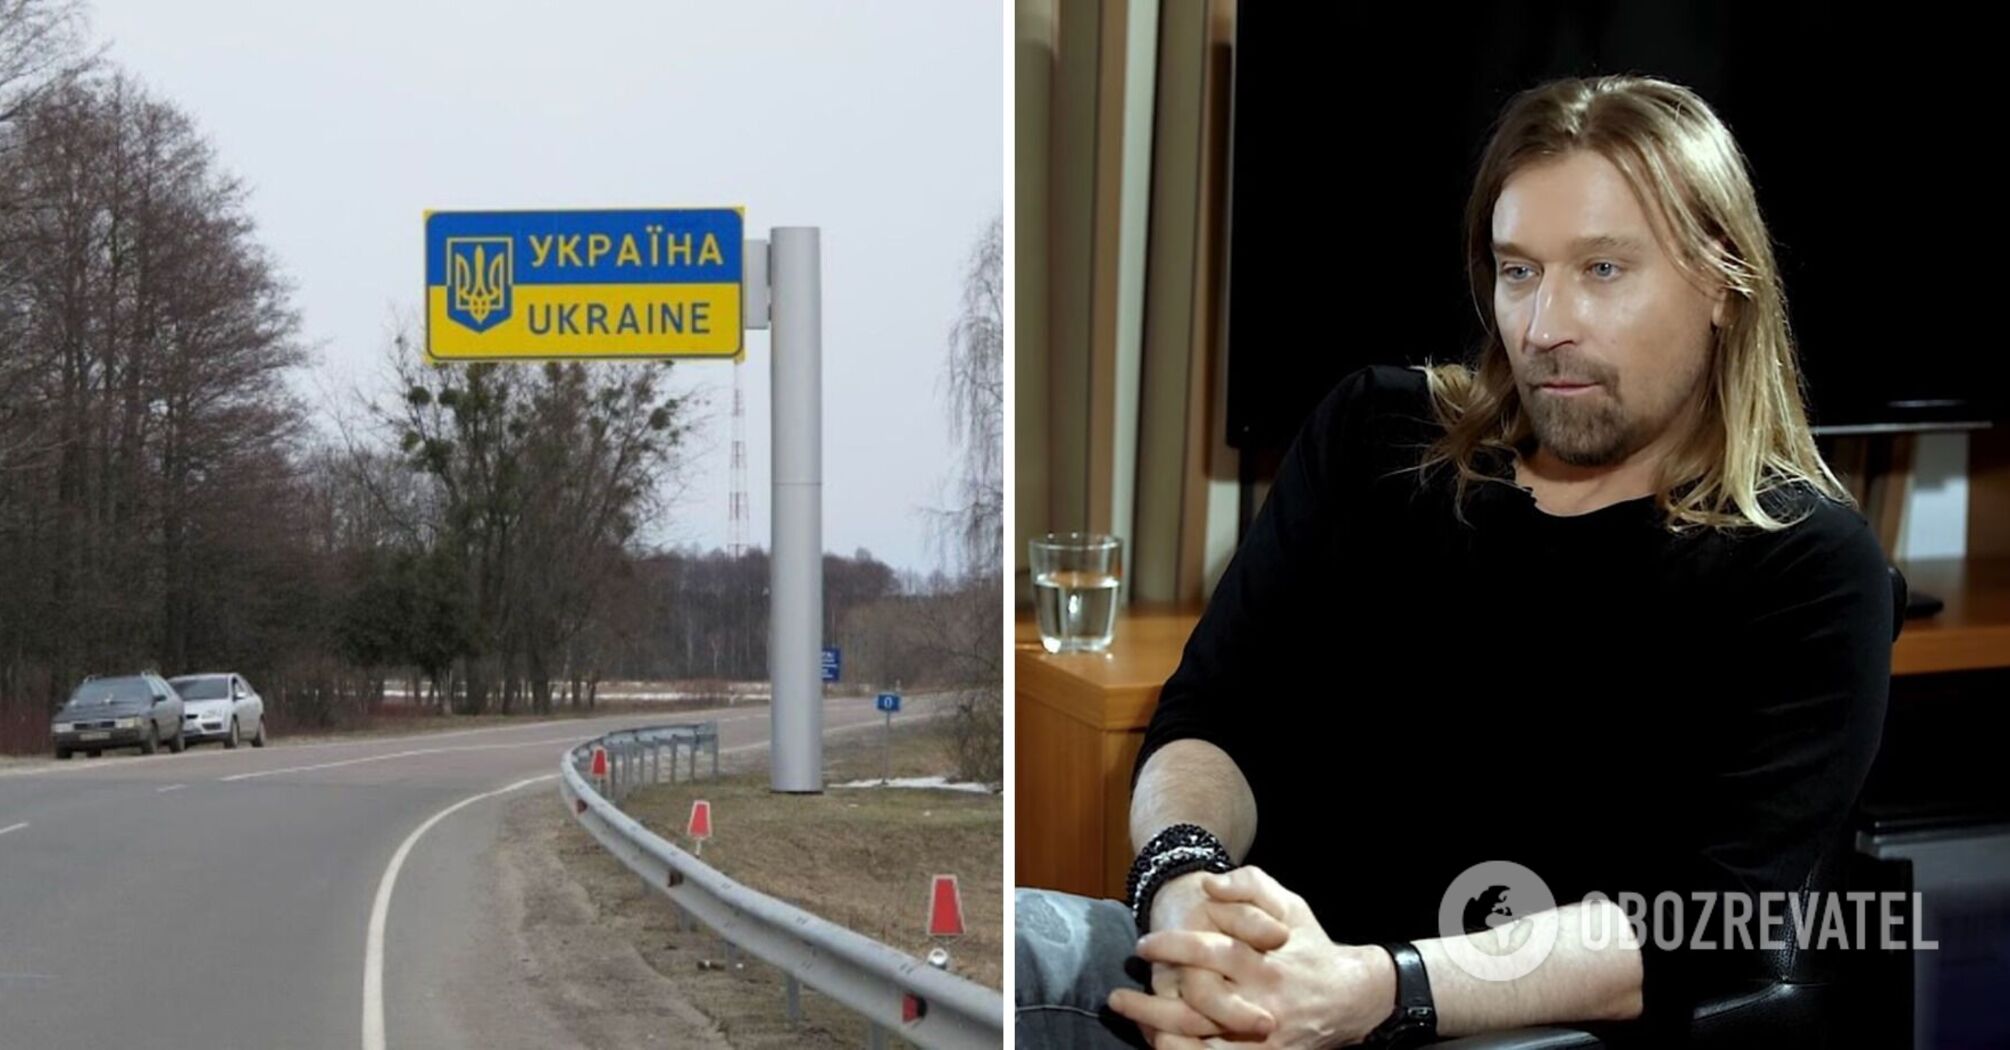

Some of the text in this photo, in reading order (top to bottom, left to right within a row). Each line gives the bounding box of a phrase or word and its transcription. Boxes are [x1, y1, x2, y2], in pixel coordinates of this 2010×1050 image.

[529, 225, 723, 267] УКРАЇНА
[528, 303, 711, 335] UKRAINE
[884, 696, 892, 709] 0
